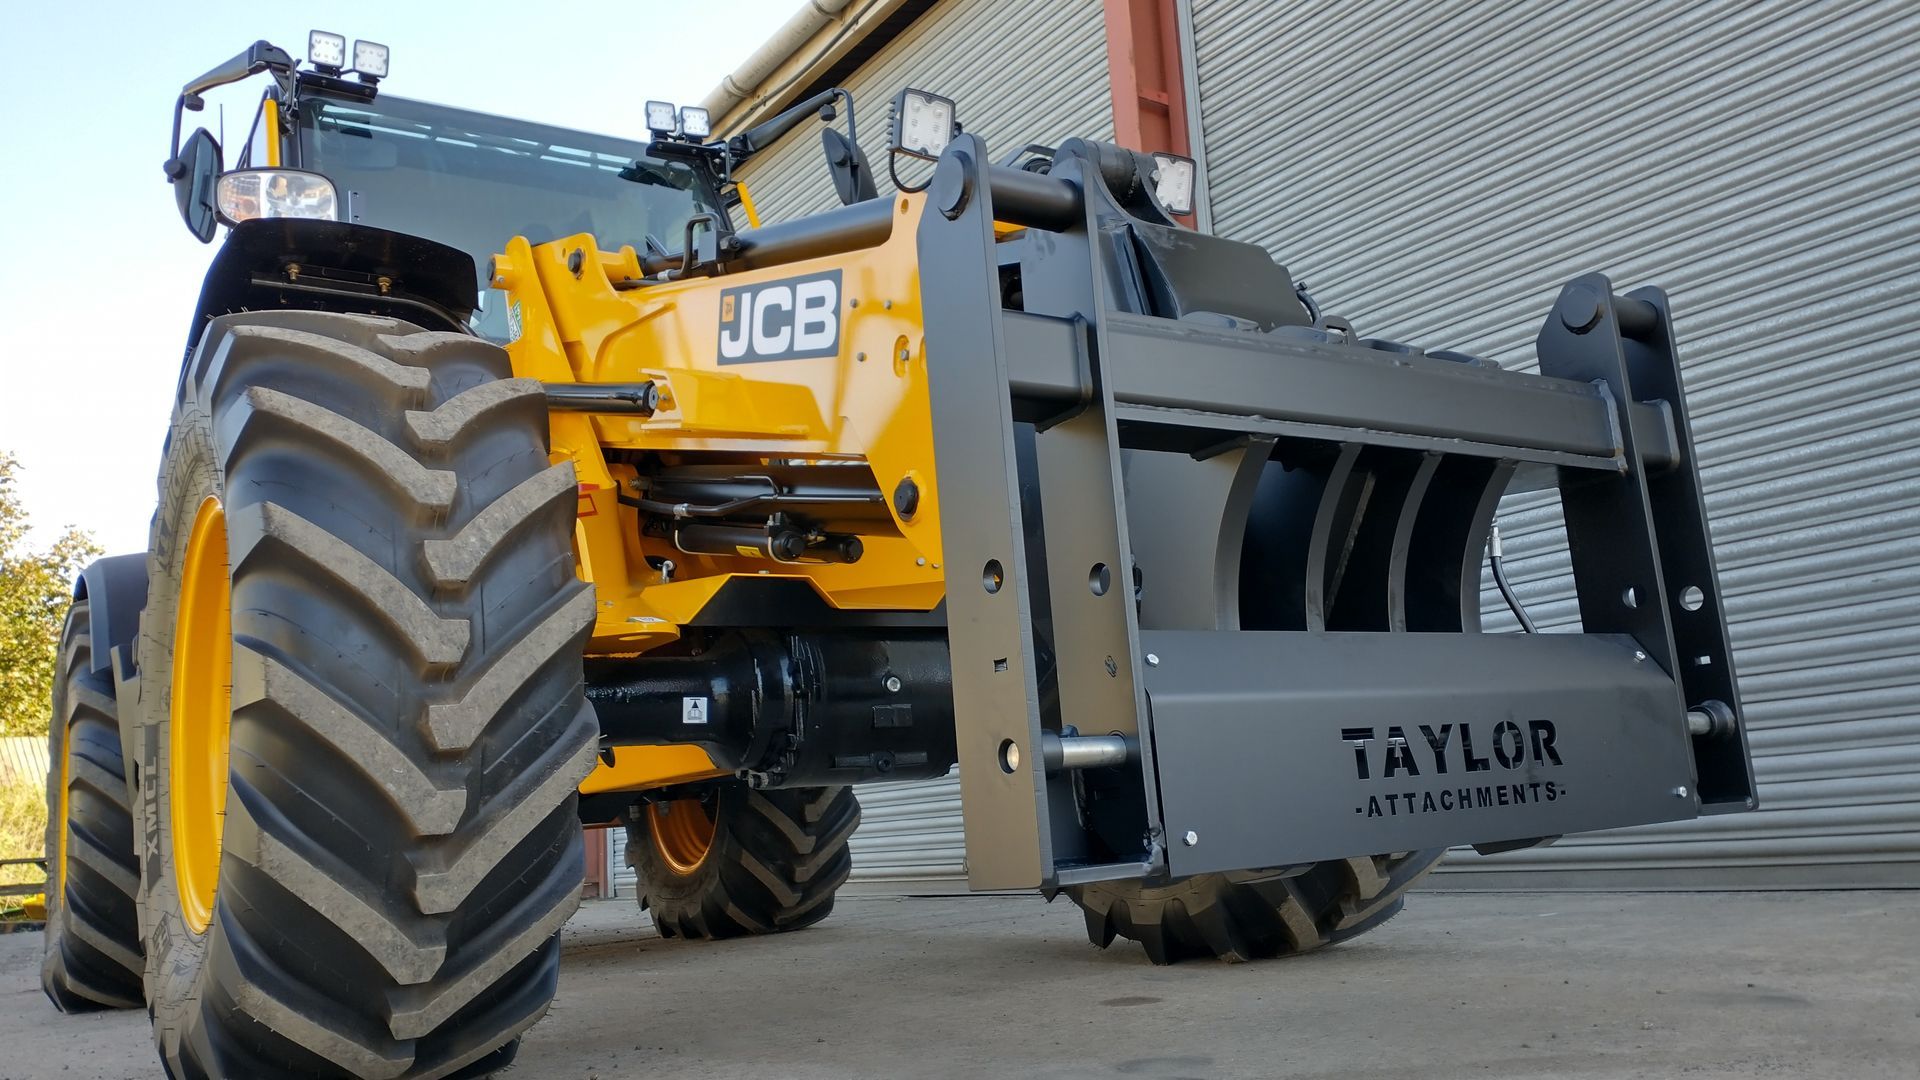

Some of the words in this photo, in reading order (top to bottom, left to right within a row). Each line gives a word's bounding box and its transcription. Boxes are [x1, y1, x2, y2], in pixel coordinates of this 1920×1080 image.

[721, 279, 837, 358] JCB
[1341, 720, 1563, 779] TAYLOR
[145, 756, 159, 863] XMCL
